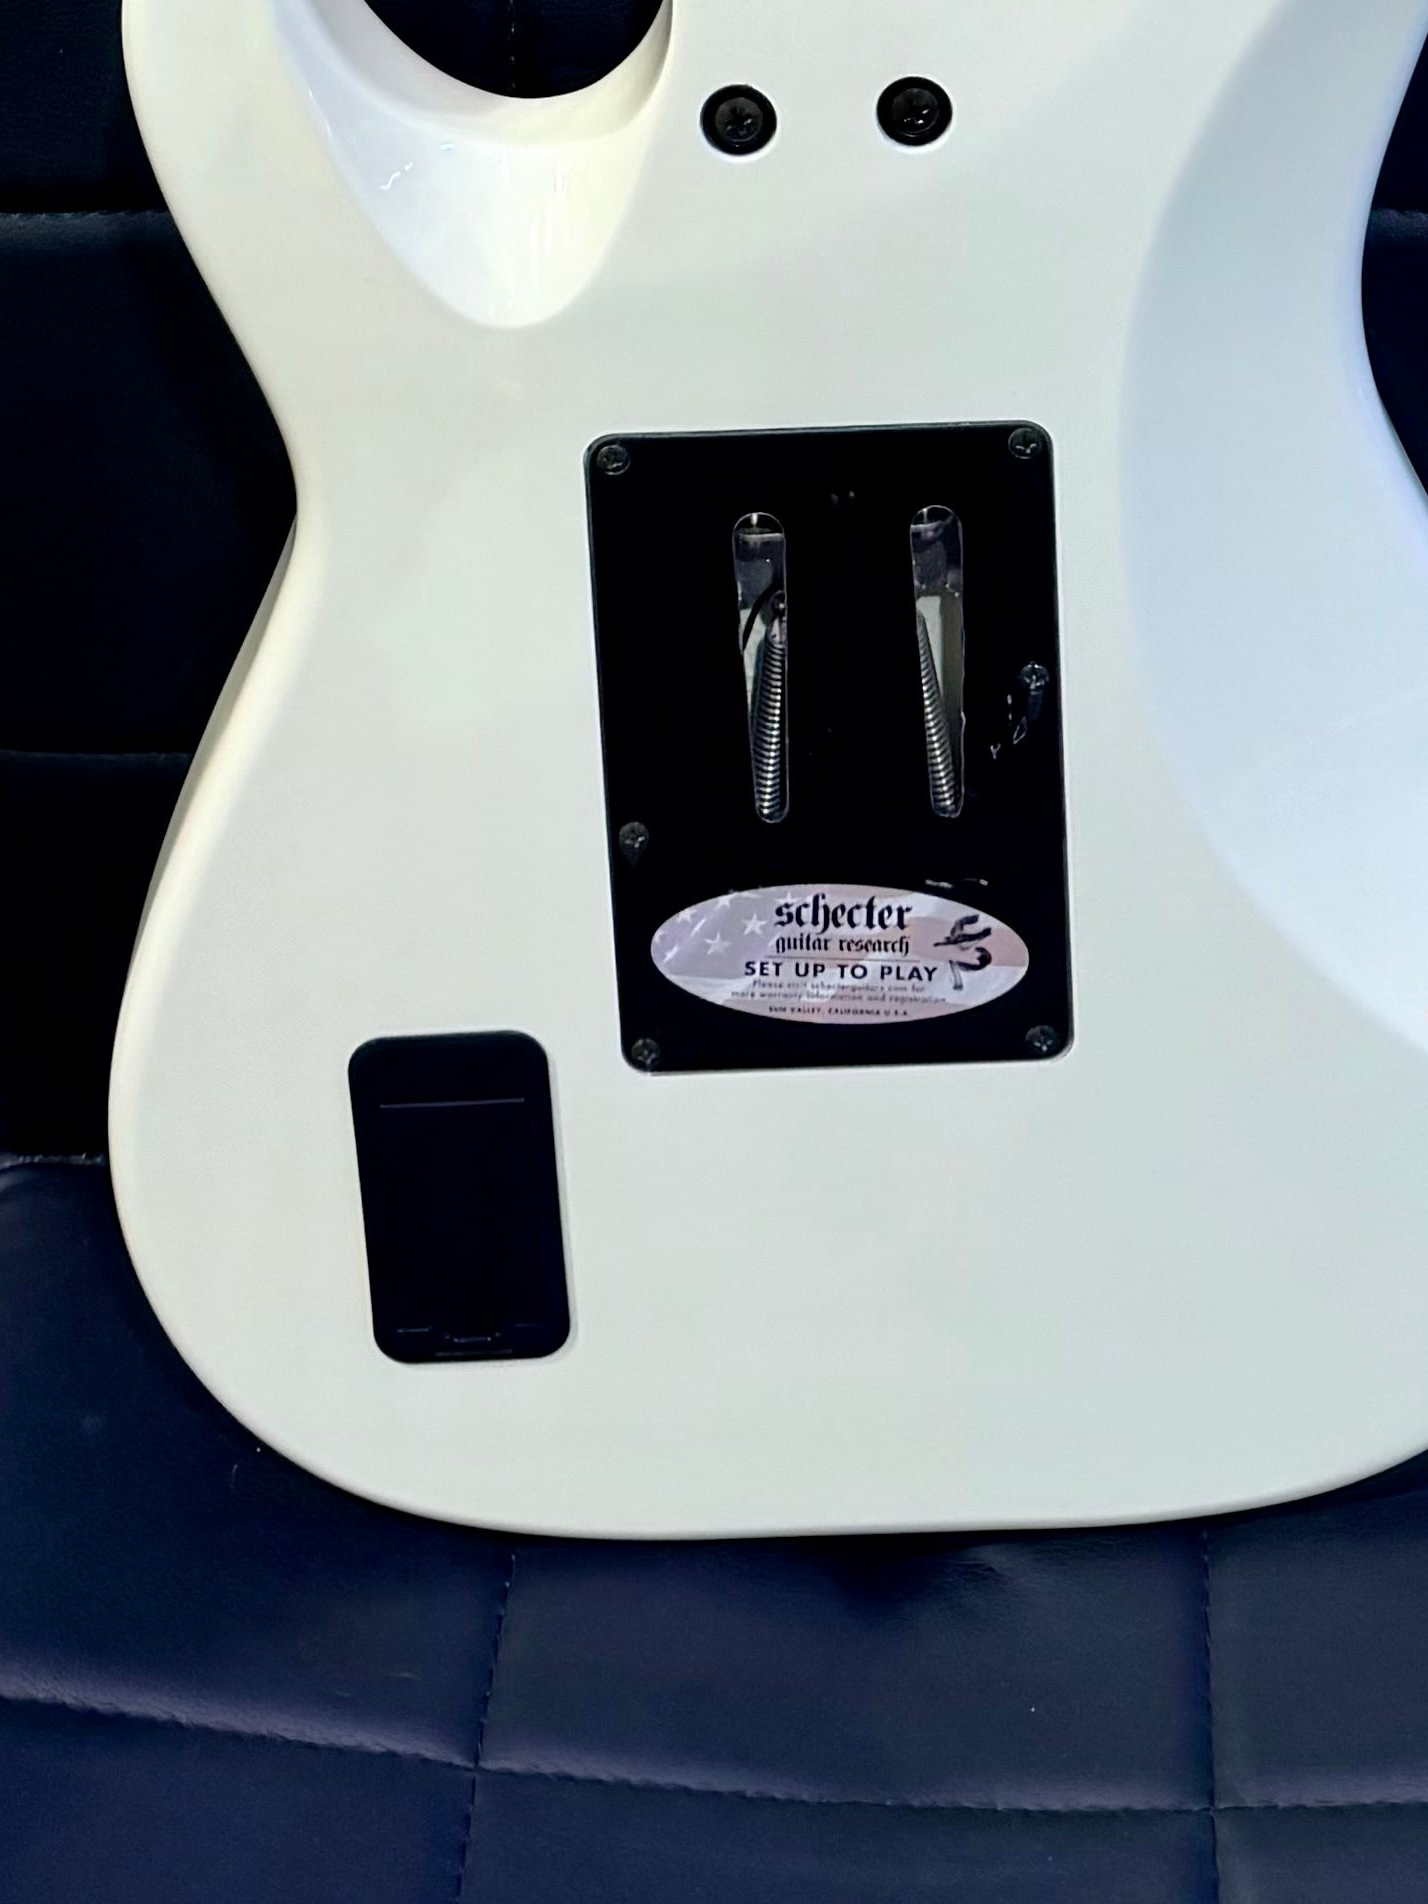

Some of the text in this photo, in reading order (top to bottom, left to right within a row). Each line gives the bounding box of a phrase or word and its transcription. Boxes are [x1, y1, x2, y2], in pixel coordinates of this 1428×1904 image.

[774, 893, 912, 935] schecter
[775, 932, 910, 957] guitar research
[744, 960, 937, 982] SET UP TO PLAY
